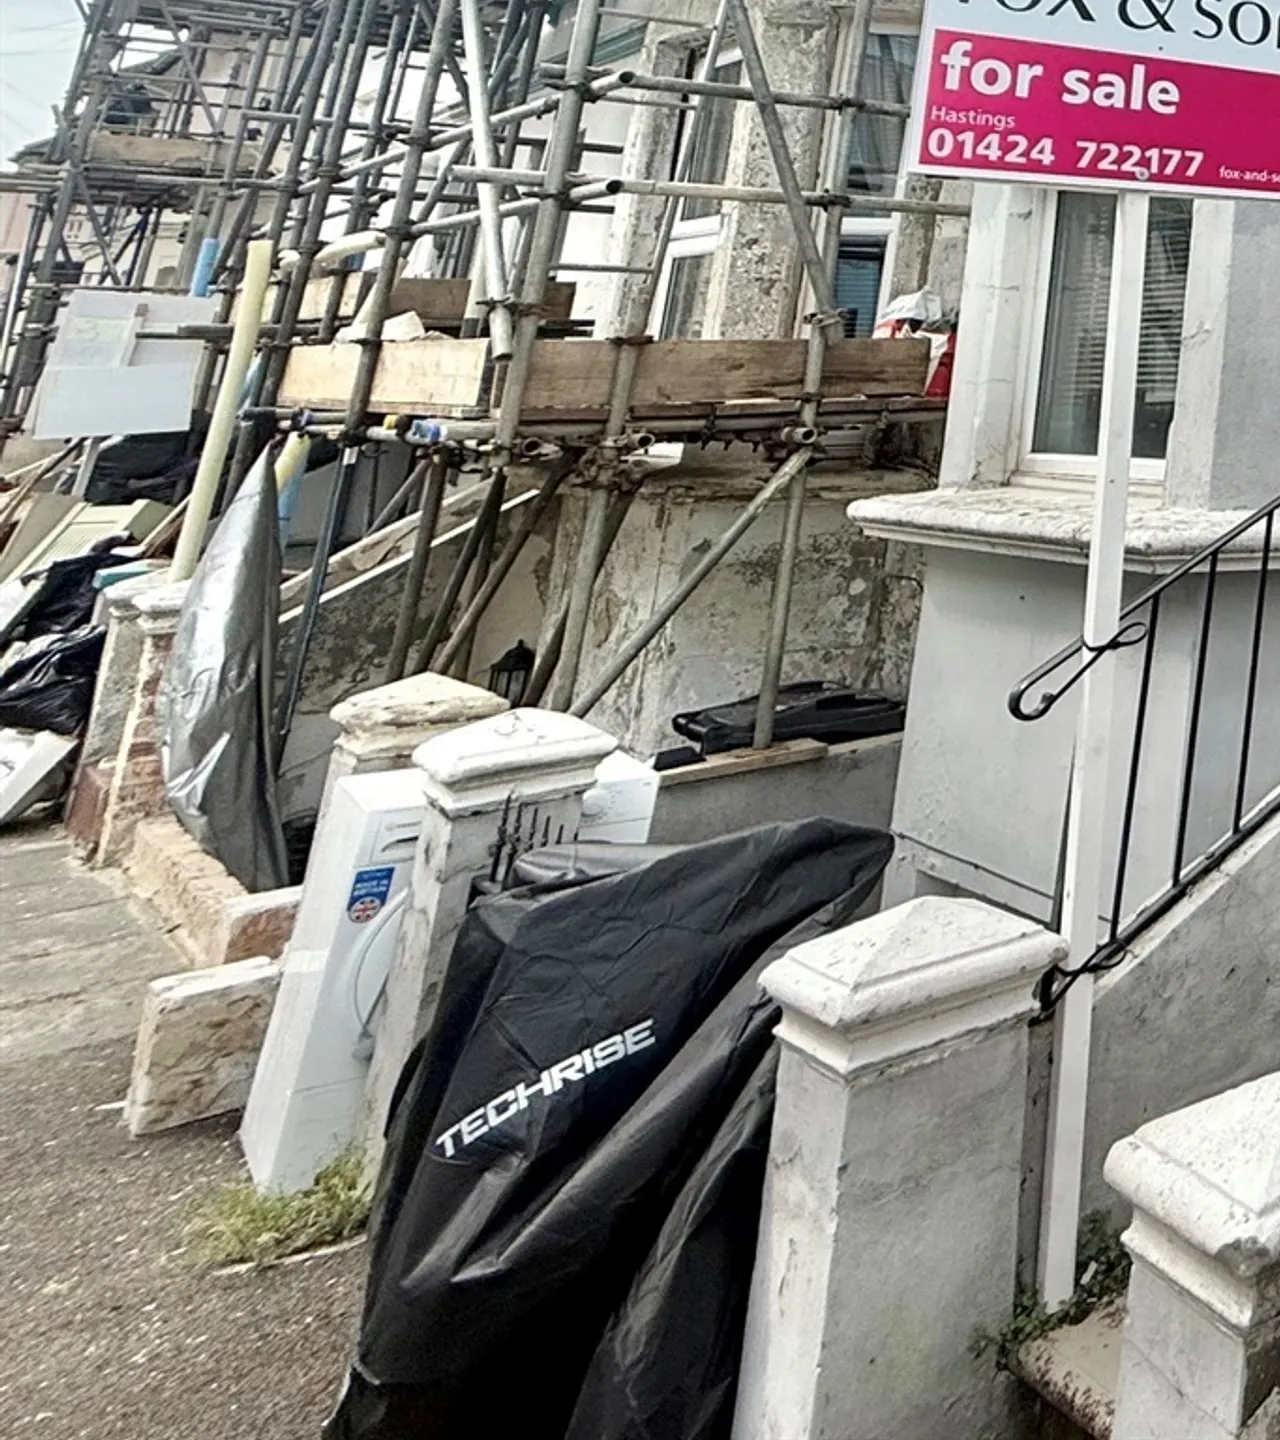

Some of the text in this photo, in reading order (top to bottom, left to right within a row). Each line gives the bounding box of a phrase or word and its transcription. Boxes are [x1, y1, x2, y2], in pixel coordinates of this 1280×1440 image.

[940, 41, 1181, 114] for sale
[930, 105, 1015, 129] Hastings
[927, 128, 1204, 177] 01424 722177
[434, 1017, 656, 1160] TECHRISE
